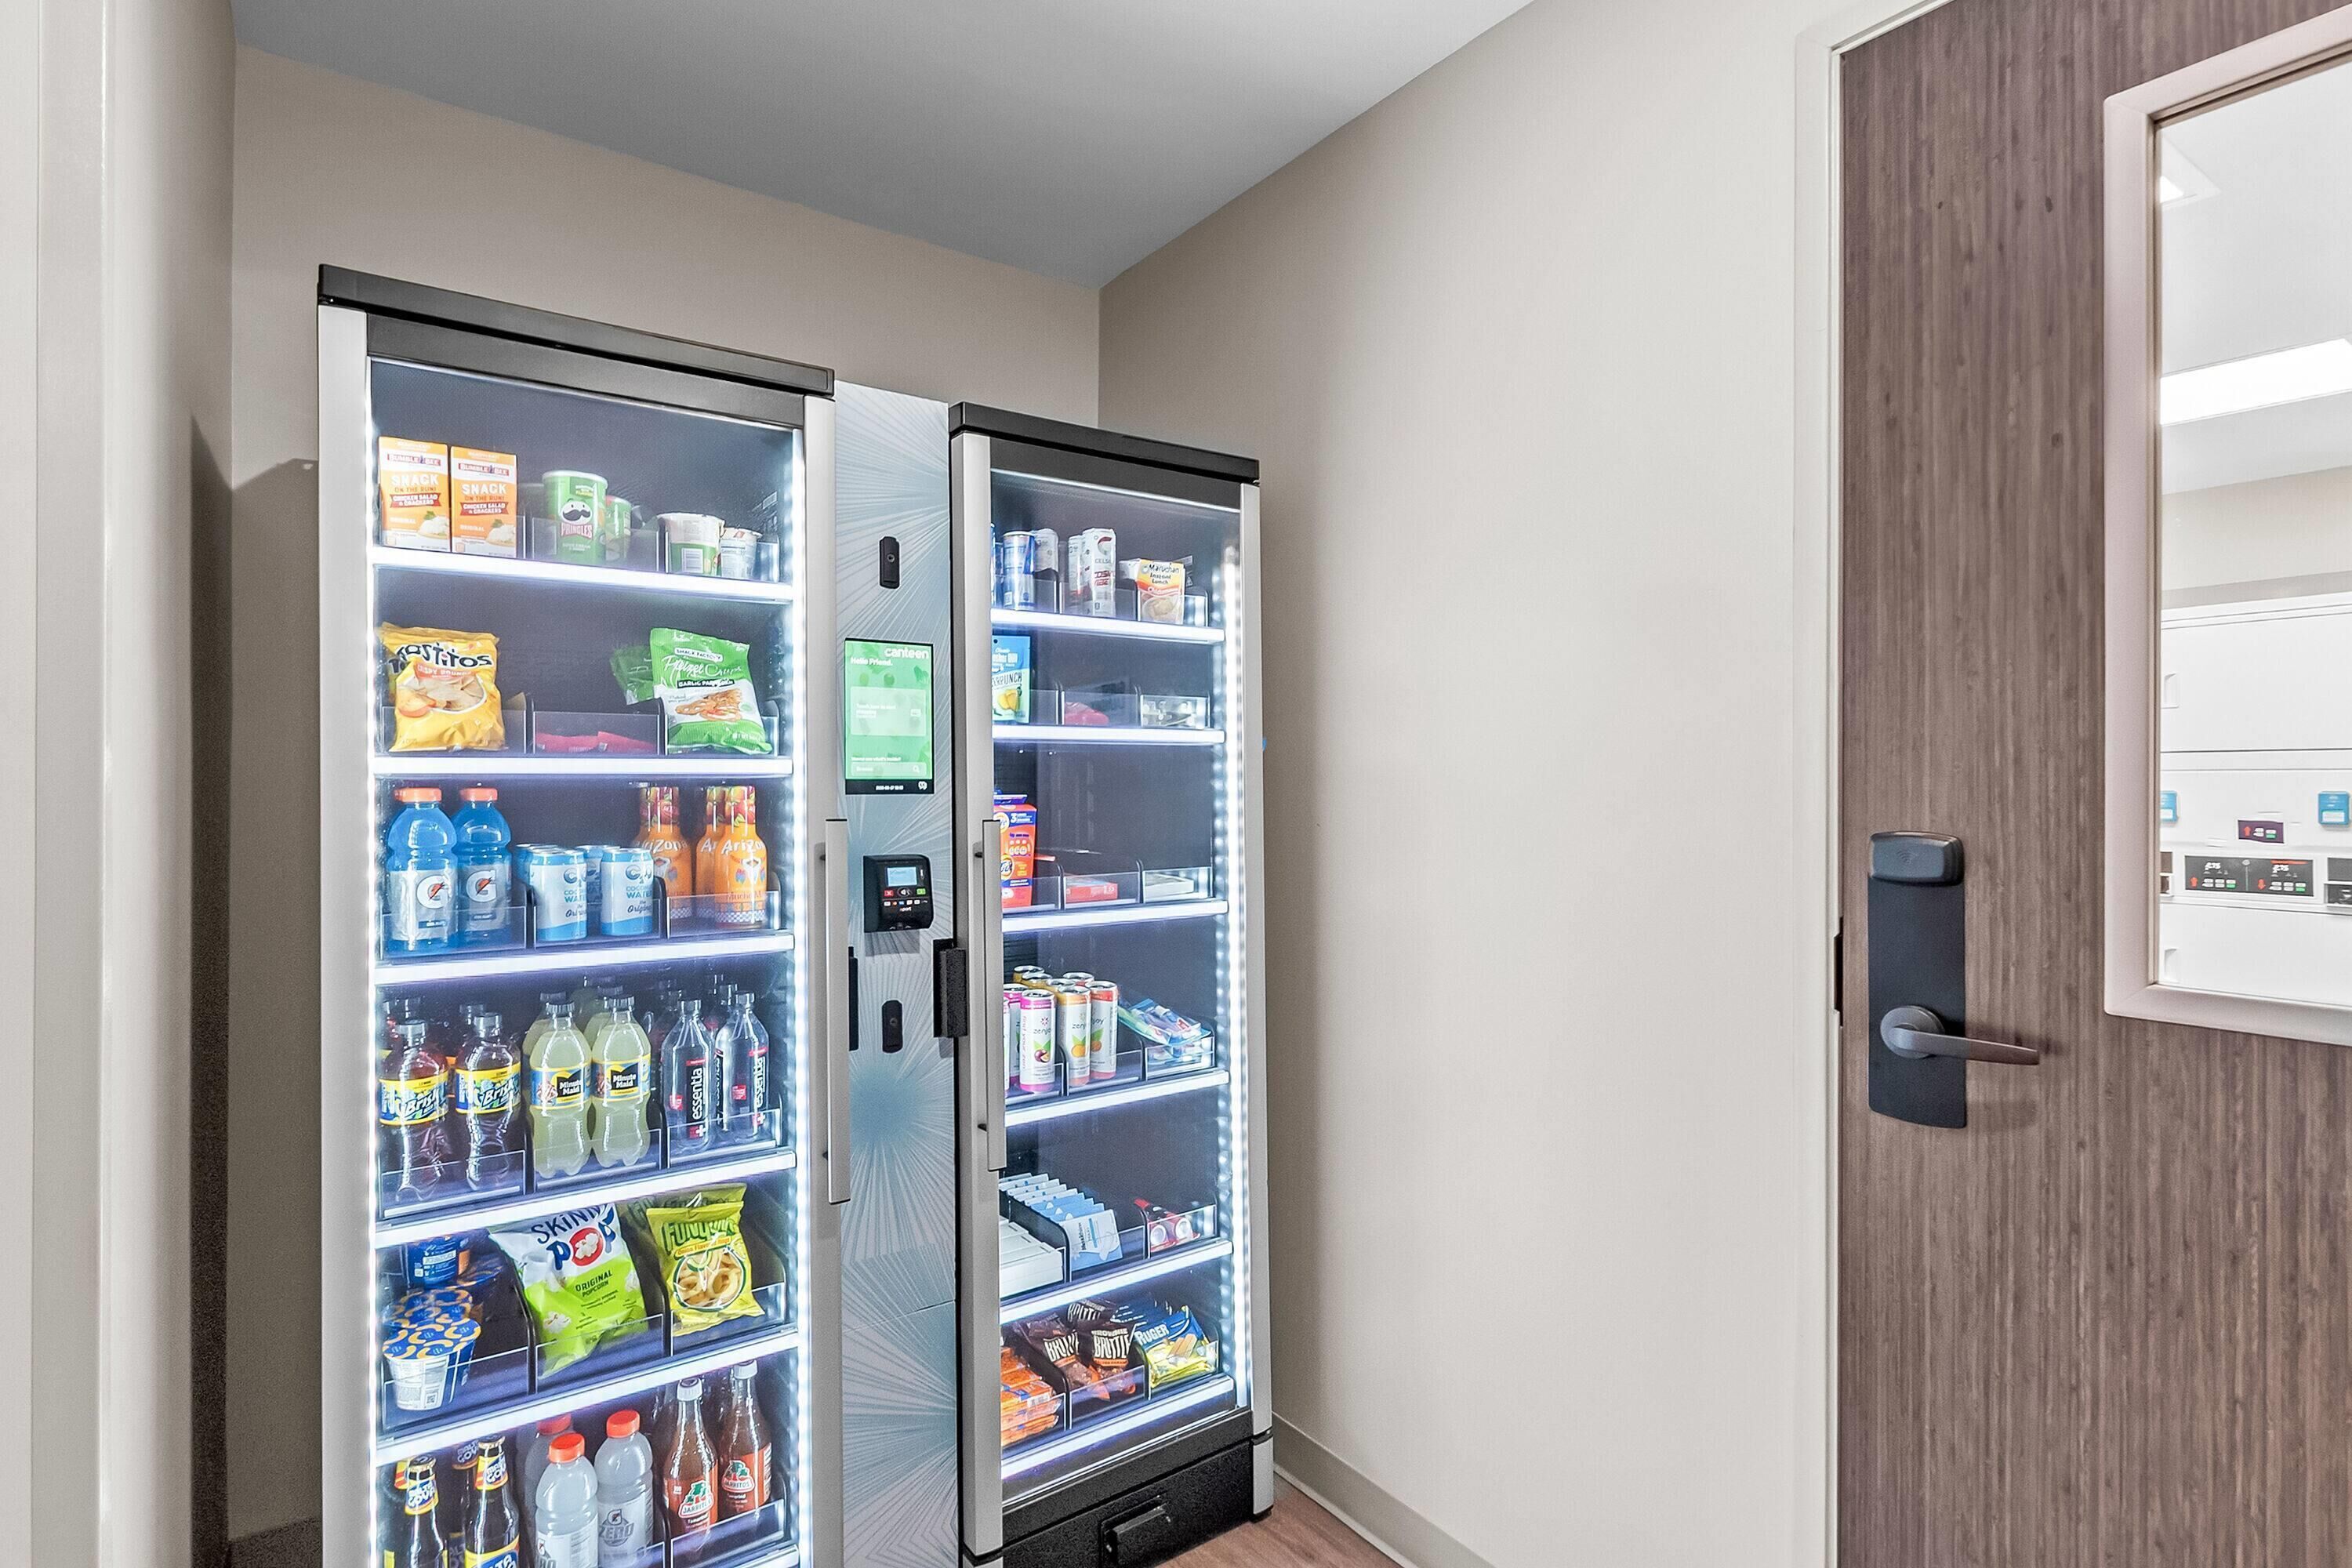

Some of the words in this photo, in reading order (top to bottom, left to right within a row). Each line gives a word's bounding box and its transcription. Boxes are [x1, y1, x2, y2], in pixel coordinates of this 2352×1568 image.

[391, 474, 439, 487] SNACK
[462, 483, 507, 495] SNACK
[561, 521, 593, 539] PRINGLES
[1149, 564, 1180, 574] Maruchan
[884, 646, 929, 659] canteen
[1010, 813, 1018, 823] 3
[416, 874, 452, 909] G
[465, 869, 497, 903] G
[612, 1073, 637, 1082] Minute
[616, 1080, 633, 1088] Maid
[482, 1077, 515, 1107] Brisk
[562, 1086, 581, 1096] Maid
[690, 1067, 703, 1120] essentia
[405, 1088, 439, 1117] Brisk
[575, 1269, 613, 1292] ORIGINAL
[583, 1280, 609, 1298] POPCORN
[1134, 1323, 1170, 1345] RUGER
[1094, 1334, 1130, 1359] BRITTLE
[724, 1480, 750, 1489] JARRITOS
[598, 1522, 635, 1540] ZERO
